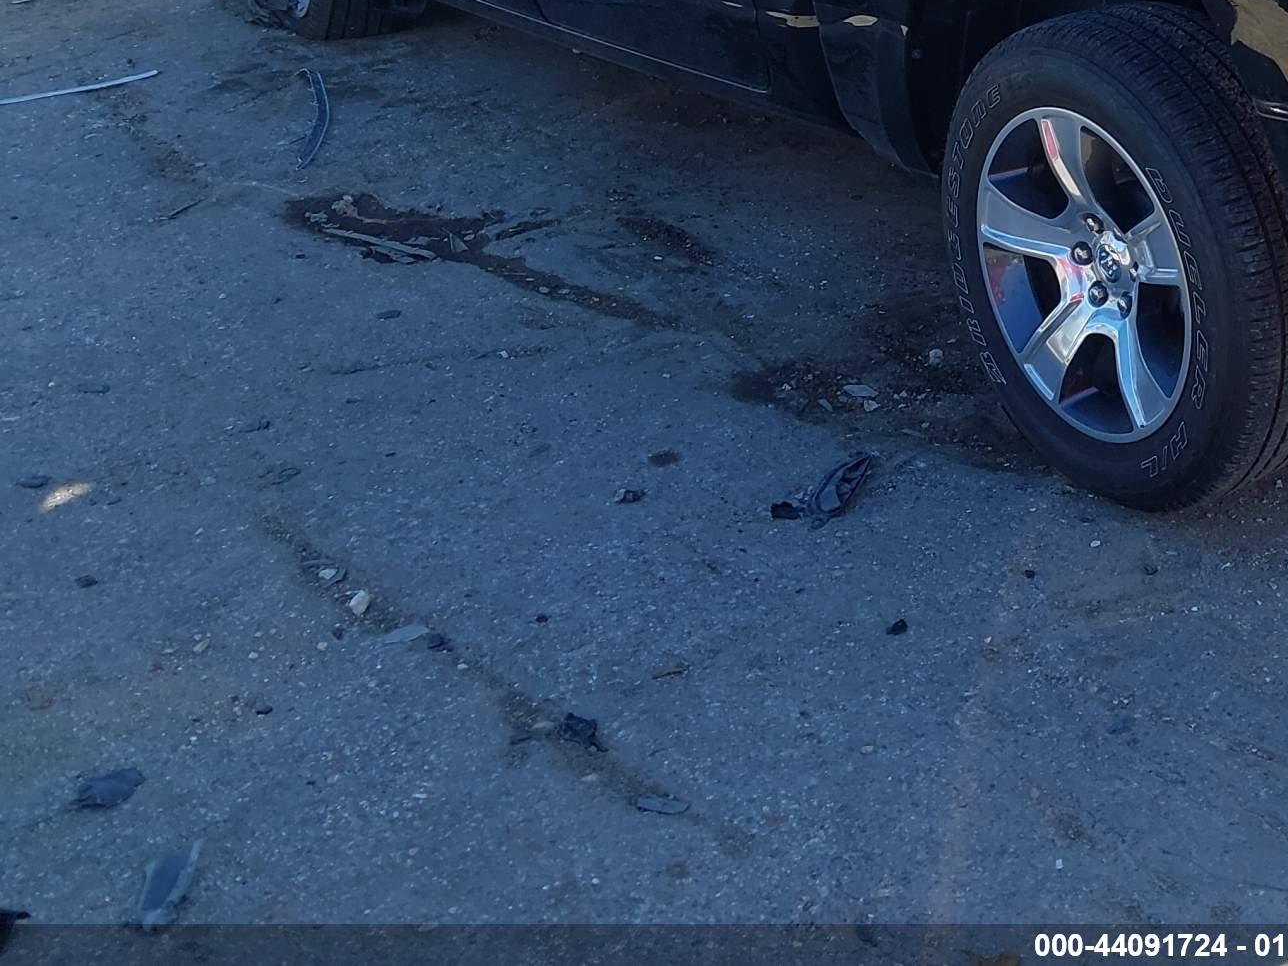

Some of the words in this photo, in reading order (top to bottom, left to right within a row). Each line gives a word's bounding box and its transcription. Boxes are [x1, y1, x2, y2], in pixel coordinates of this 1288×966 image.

[946, 84, 1007, 387] BRIDGESTONE
[1144, 165, 1211, 411] DUELER
[1141, 421, 1188, 478] H/L
